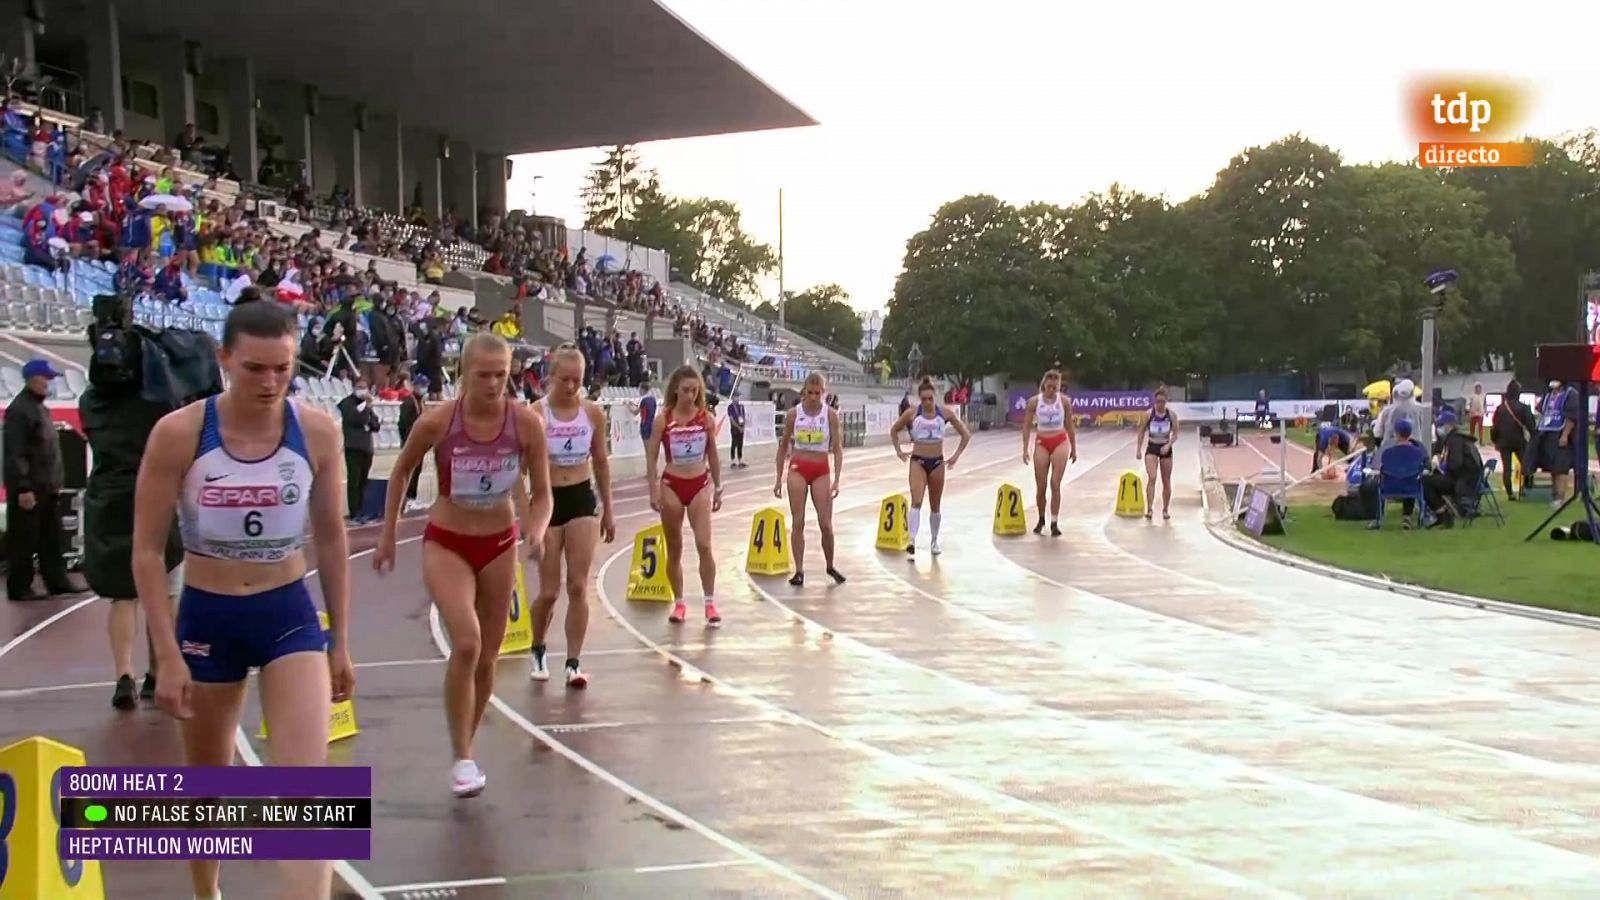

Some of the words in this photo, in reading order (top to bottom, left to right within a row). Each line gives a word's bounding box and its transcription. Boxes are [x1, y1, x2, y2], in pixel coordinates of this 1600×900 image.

[1091, 396, 1150, 407] ATHLETICS
[563, 438, 573, 451] 4
[806, 433, 811, 443] 1
[480, 475, 492, 492] 5
[1132, 479, 1138, 502] 1
[202, 488, 276, 505] SPAR
[1009, 491, 1018, 517] 2
[243, 510, 263, 537] 6
[884, 502, 895, 532] 3
[753, 519, 765, 554] 4
[773, 519, 782, 554] 4
[641, 537, 657, 579] 5
